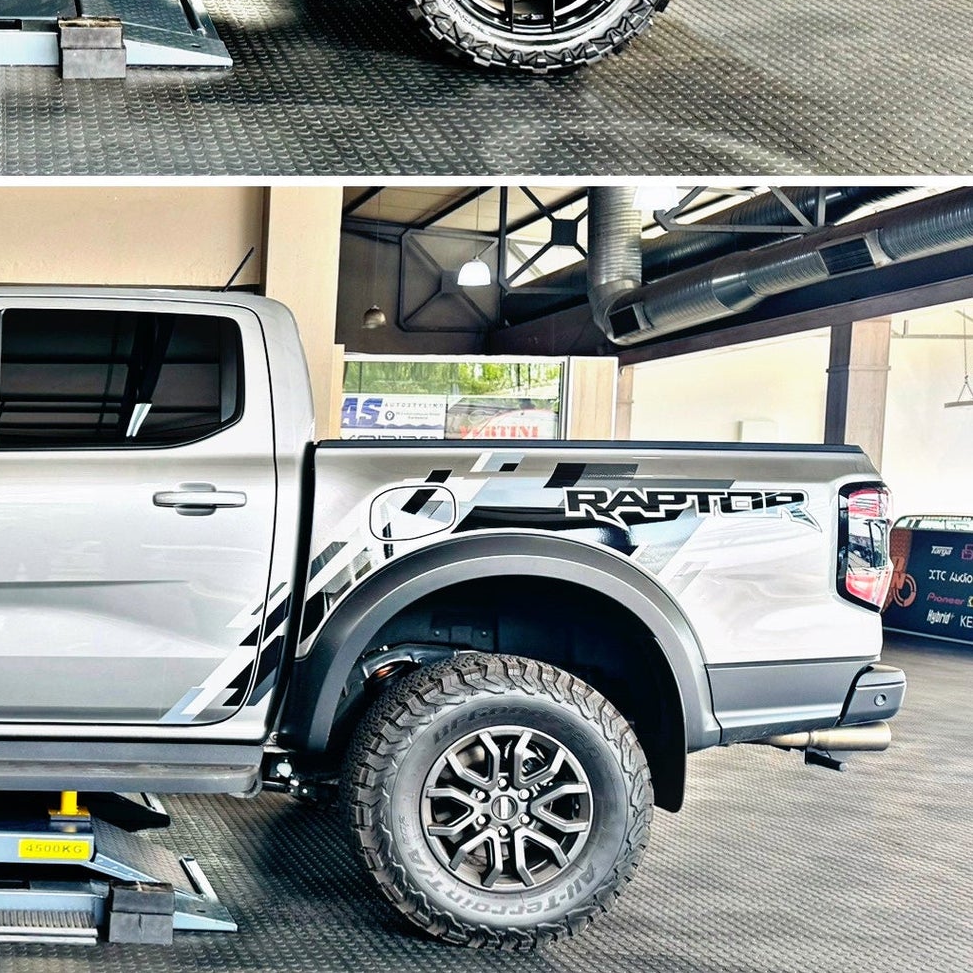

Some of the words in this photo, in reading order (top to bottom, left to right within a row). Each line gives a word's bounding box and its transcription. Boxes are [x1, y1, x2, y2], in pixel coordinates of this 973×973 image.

[341, 397, 383, 425] AS
[563, 487, 823, 532] RAPTOR
[927, 592, 965, 605] Pioneer
[26, 844, 82, 854] 4500KG
